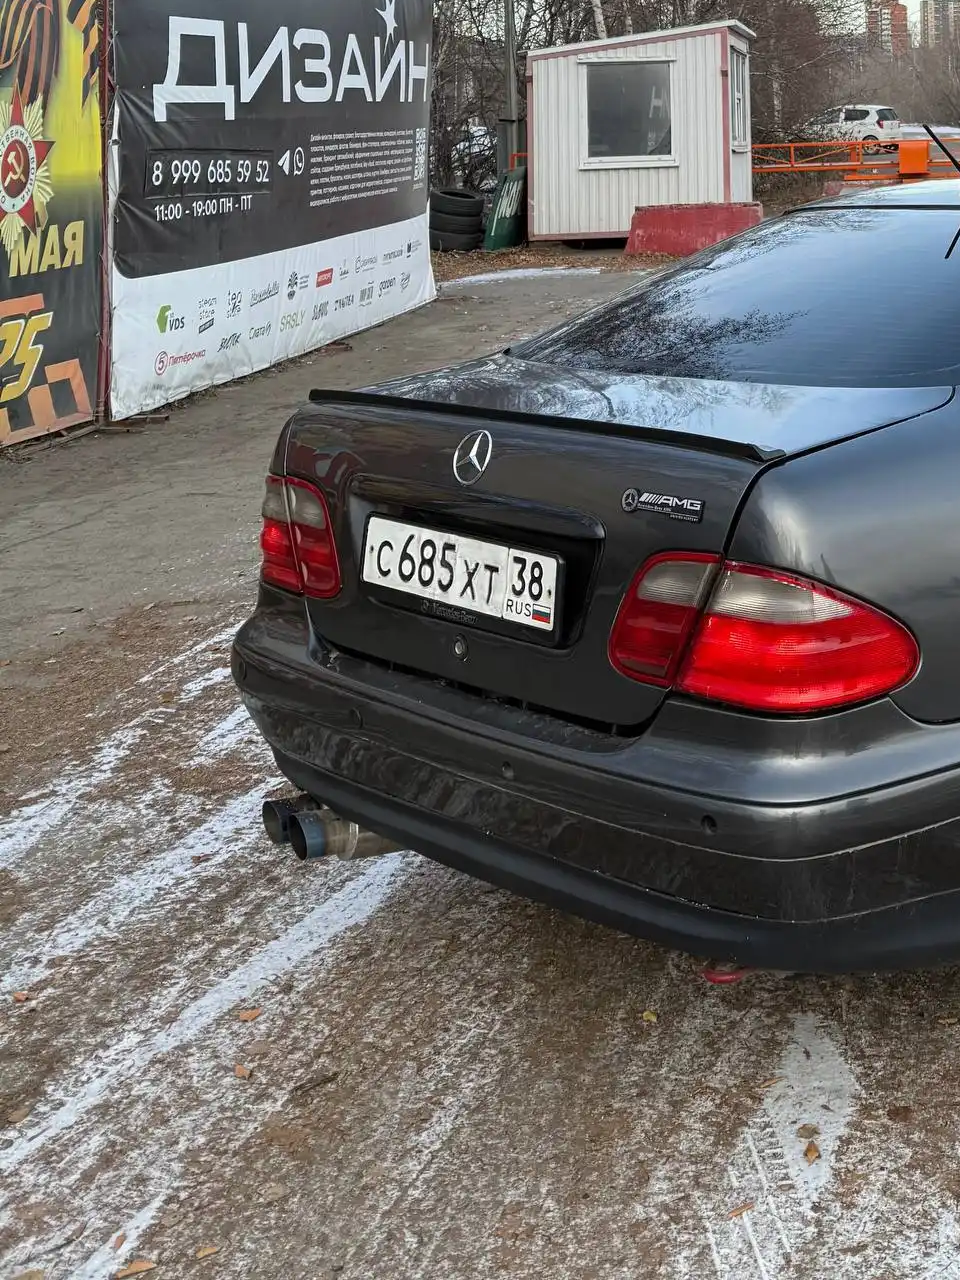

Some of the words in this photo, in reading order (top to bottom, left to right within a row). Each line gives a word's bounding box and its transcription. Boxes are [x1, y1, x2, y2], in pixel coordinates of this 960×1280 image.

[153, 16, 429, 122] ДИЗАЙН
[152, 161, 163, 185] 8
[171, 160, 201, 184] 999
[207, 160, 232, 183] 685
[236, 160, 251, 183] 59
[255, 160, 269, 182] 52
[154, 203, 182, 221] 11:00
[192, 199, 218, 217] 19:00
[219, 197, 233, 213] ПН
[241, 195, 253, 210] ПТ
[9, 220, 84, 278] МАЯ
[169, 317, 185, 331] VDS
[657, 495, 702, 510] AMG
[511, 556, 544, 602] 38
[506, 599, 531, 617] RUS
